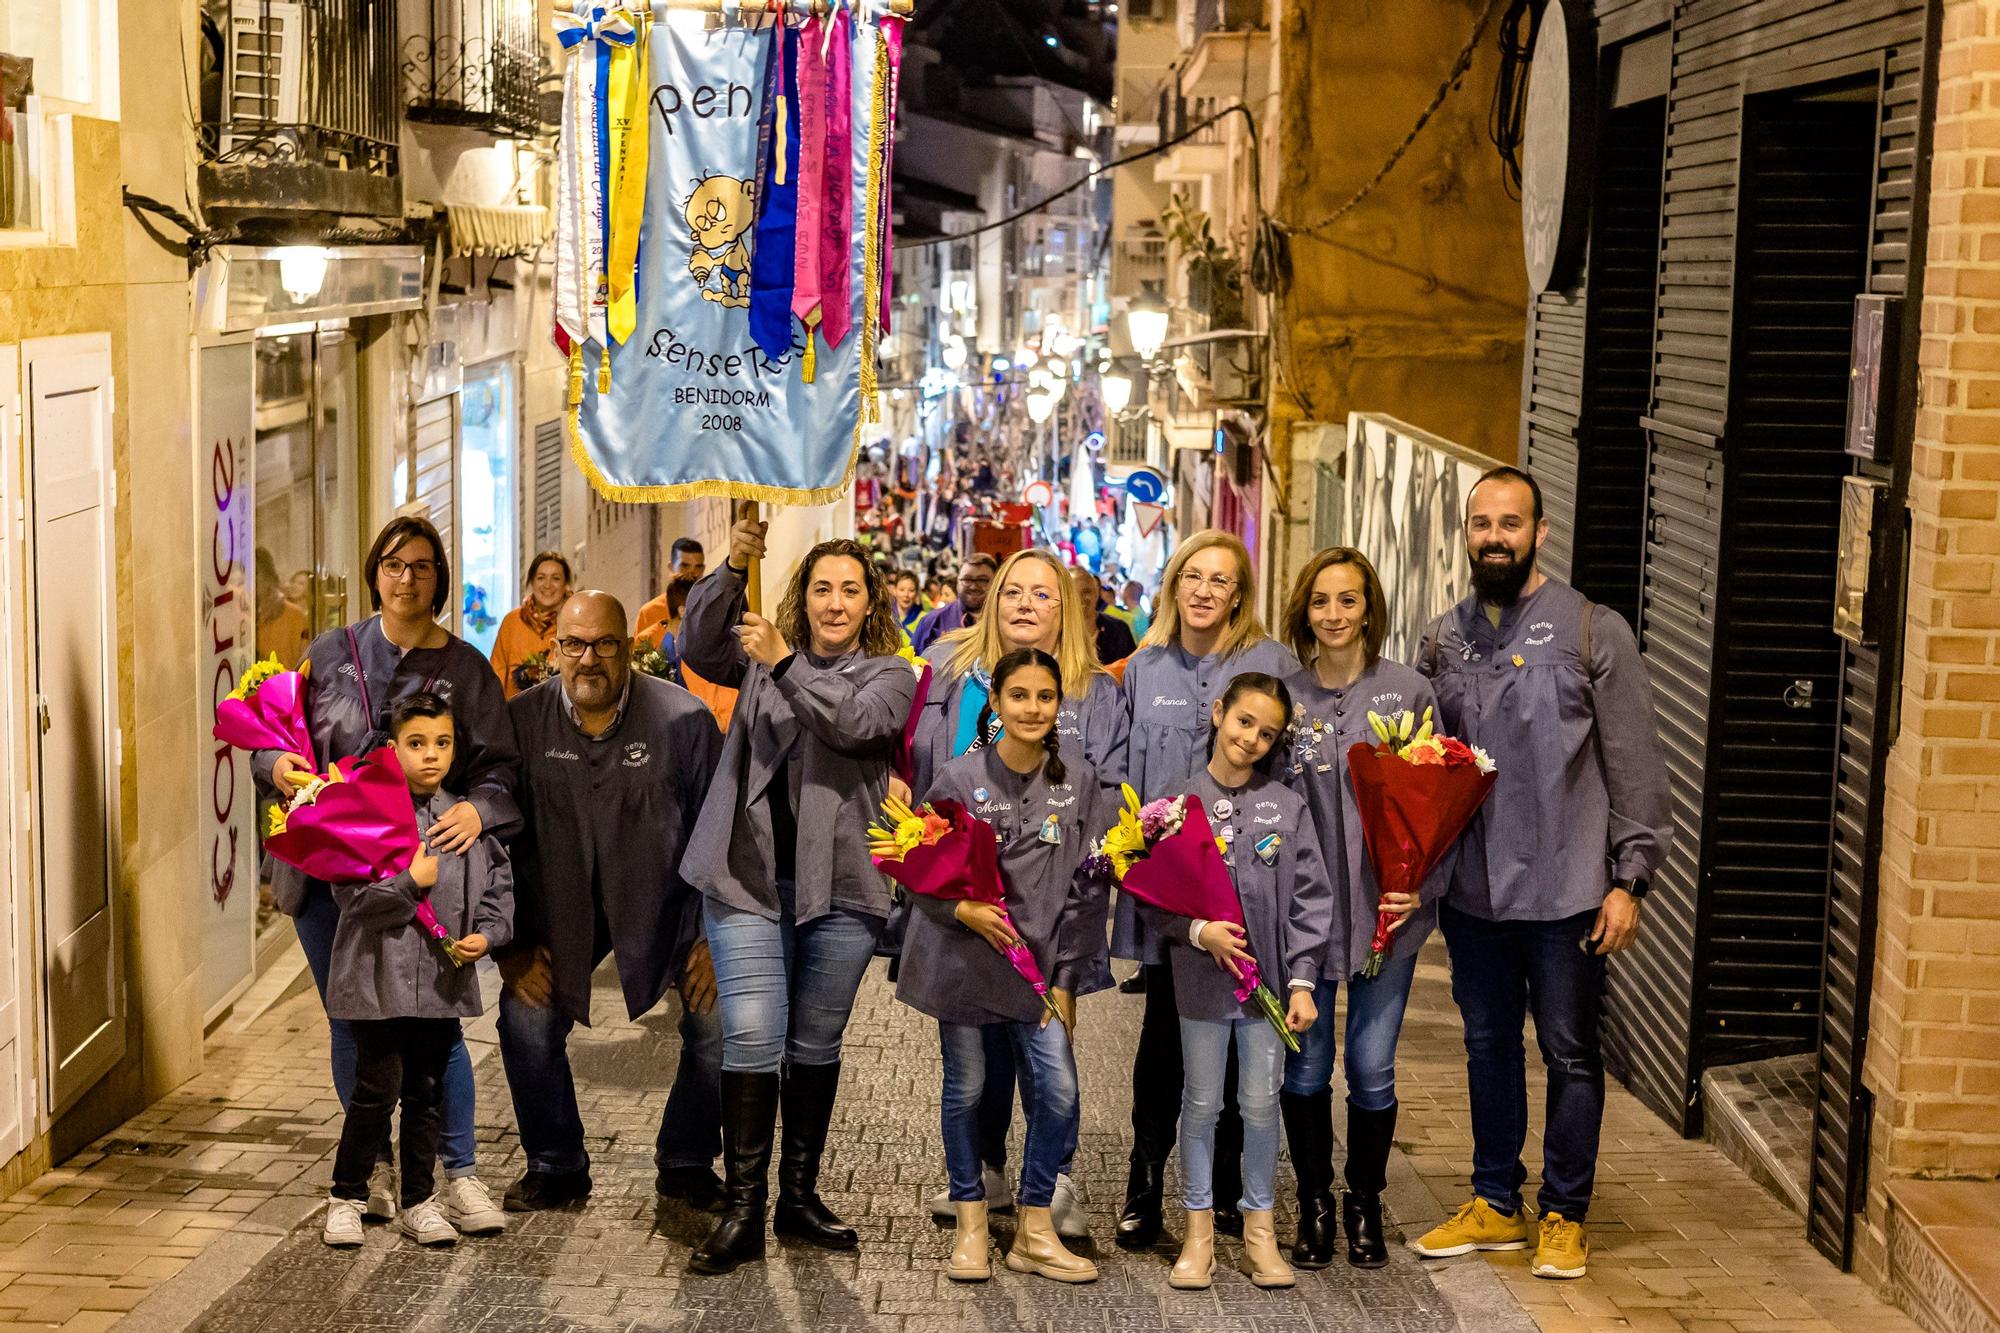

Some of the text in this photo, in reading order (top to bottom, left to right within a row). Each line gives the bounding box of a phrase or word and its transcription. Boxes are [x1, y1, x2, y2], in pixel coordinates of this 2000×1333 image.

[646, 328, 742, 377] Sense
[674, 387, 770, 408] BENIDORM
[702, 415, 742, 431] 2008
[1529, 621, 1554, 632] Penya
[1151, 695, 1188, 707] Francis
[1371, 692, 1403, 706] Penya
[624, 742, 648, 753] Penya
[1255, 801, 1279, 811] Penya
